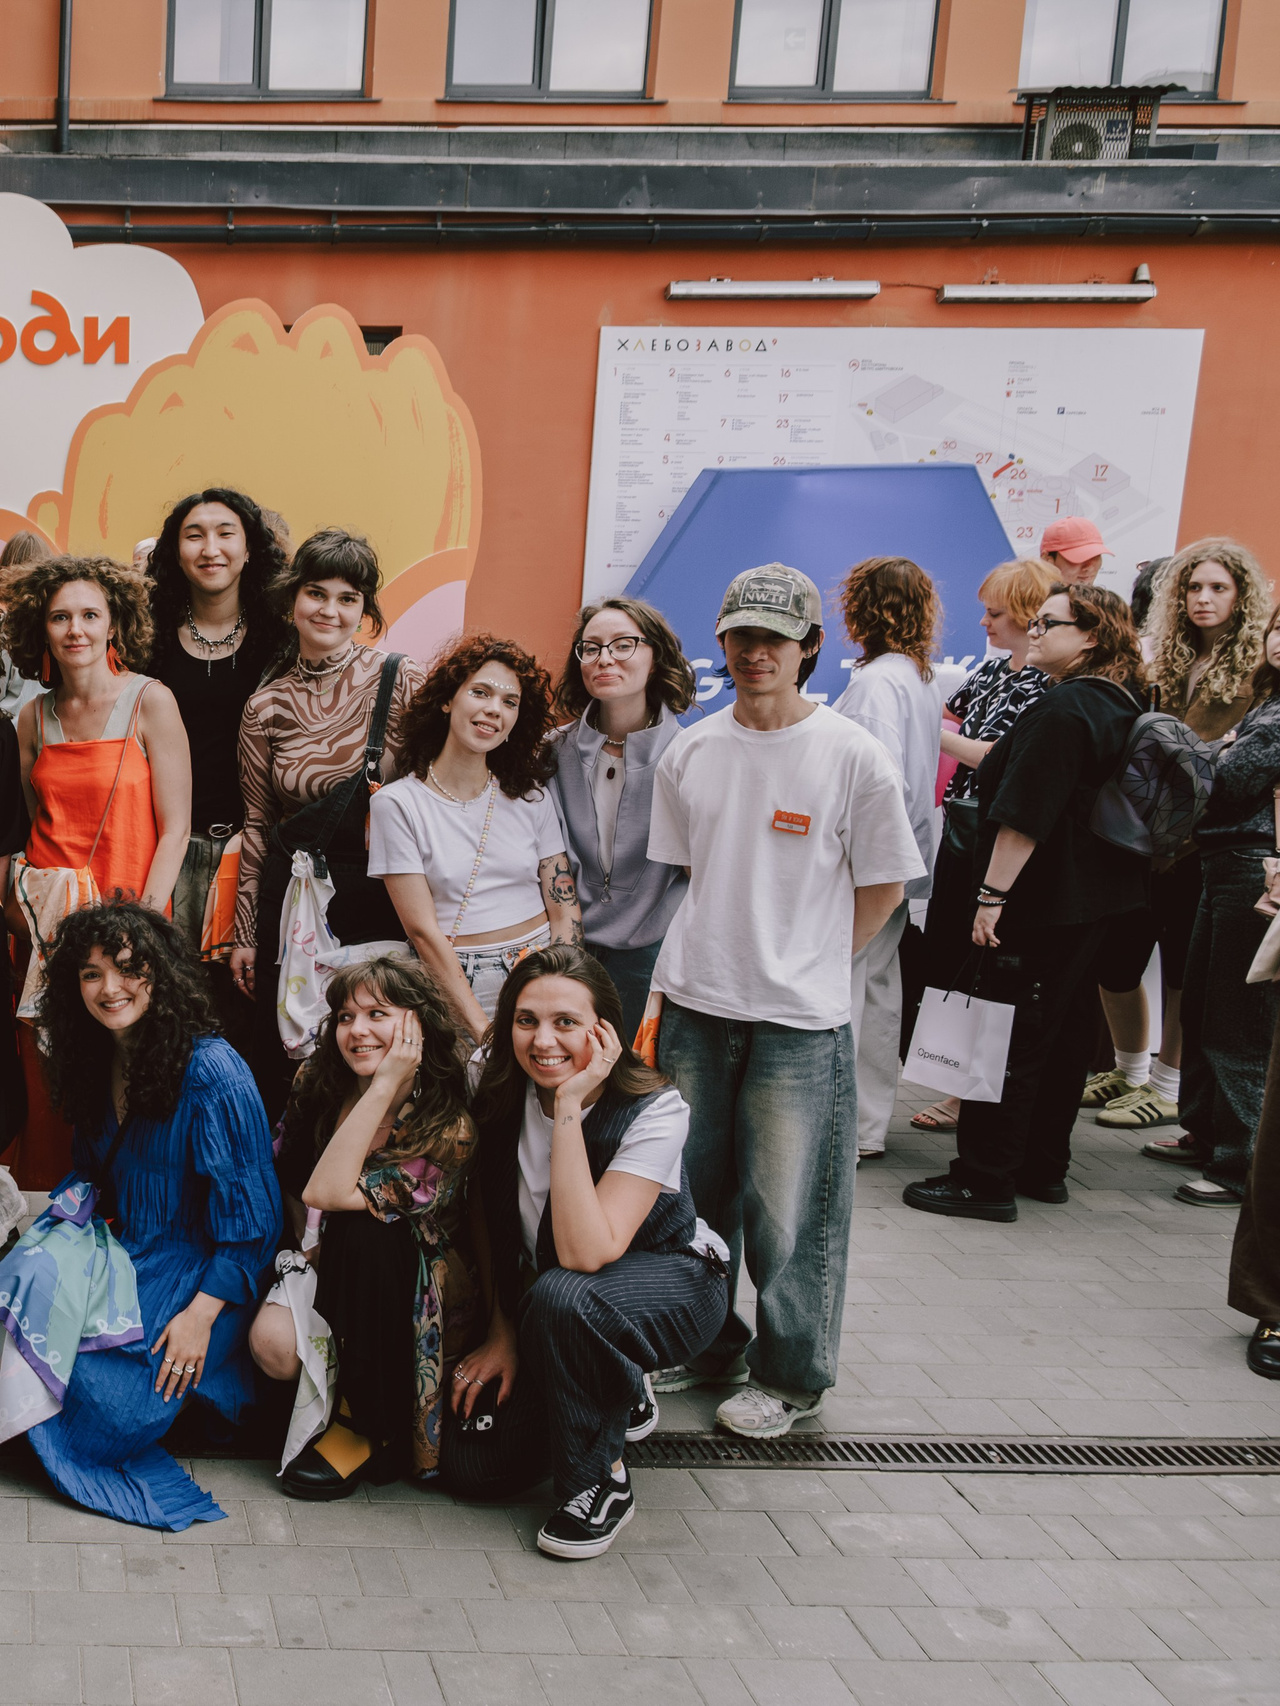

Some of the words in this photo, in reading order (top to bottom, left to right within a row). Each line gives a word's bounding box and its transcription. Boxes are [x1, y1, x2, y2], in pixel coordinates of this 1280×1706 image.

[669, 367, 676, 377] 2
[724, 369, 731, 378] 6
[780, 368, 791, 378] 16
[778, 393, 789, 403] 17
[720, 418, 727, 427] 7
[776, 419, 789, 429] 23
[663, 433, 671, 442] 4
[943, 440, 957, 450] 30
[662, 455, 669, 464] 5
[717, 456, 724, 465] 9
[773, 456, 786, 466] 26
[975, 452, 993, 464] 27
[1010, 468, 1027, 480] 26
[1095, 464, 1109, 477] 17
[1016, 527, 1034, 538] 23
[744, 592, 788, 605] NWTF
[917, 1047, 960, 1069] Openface
